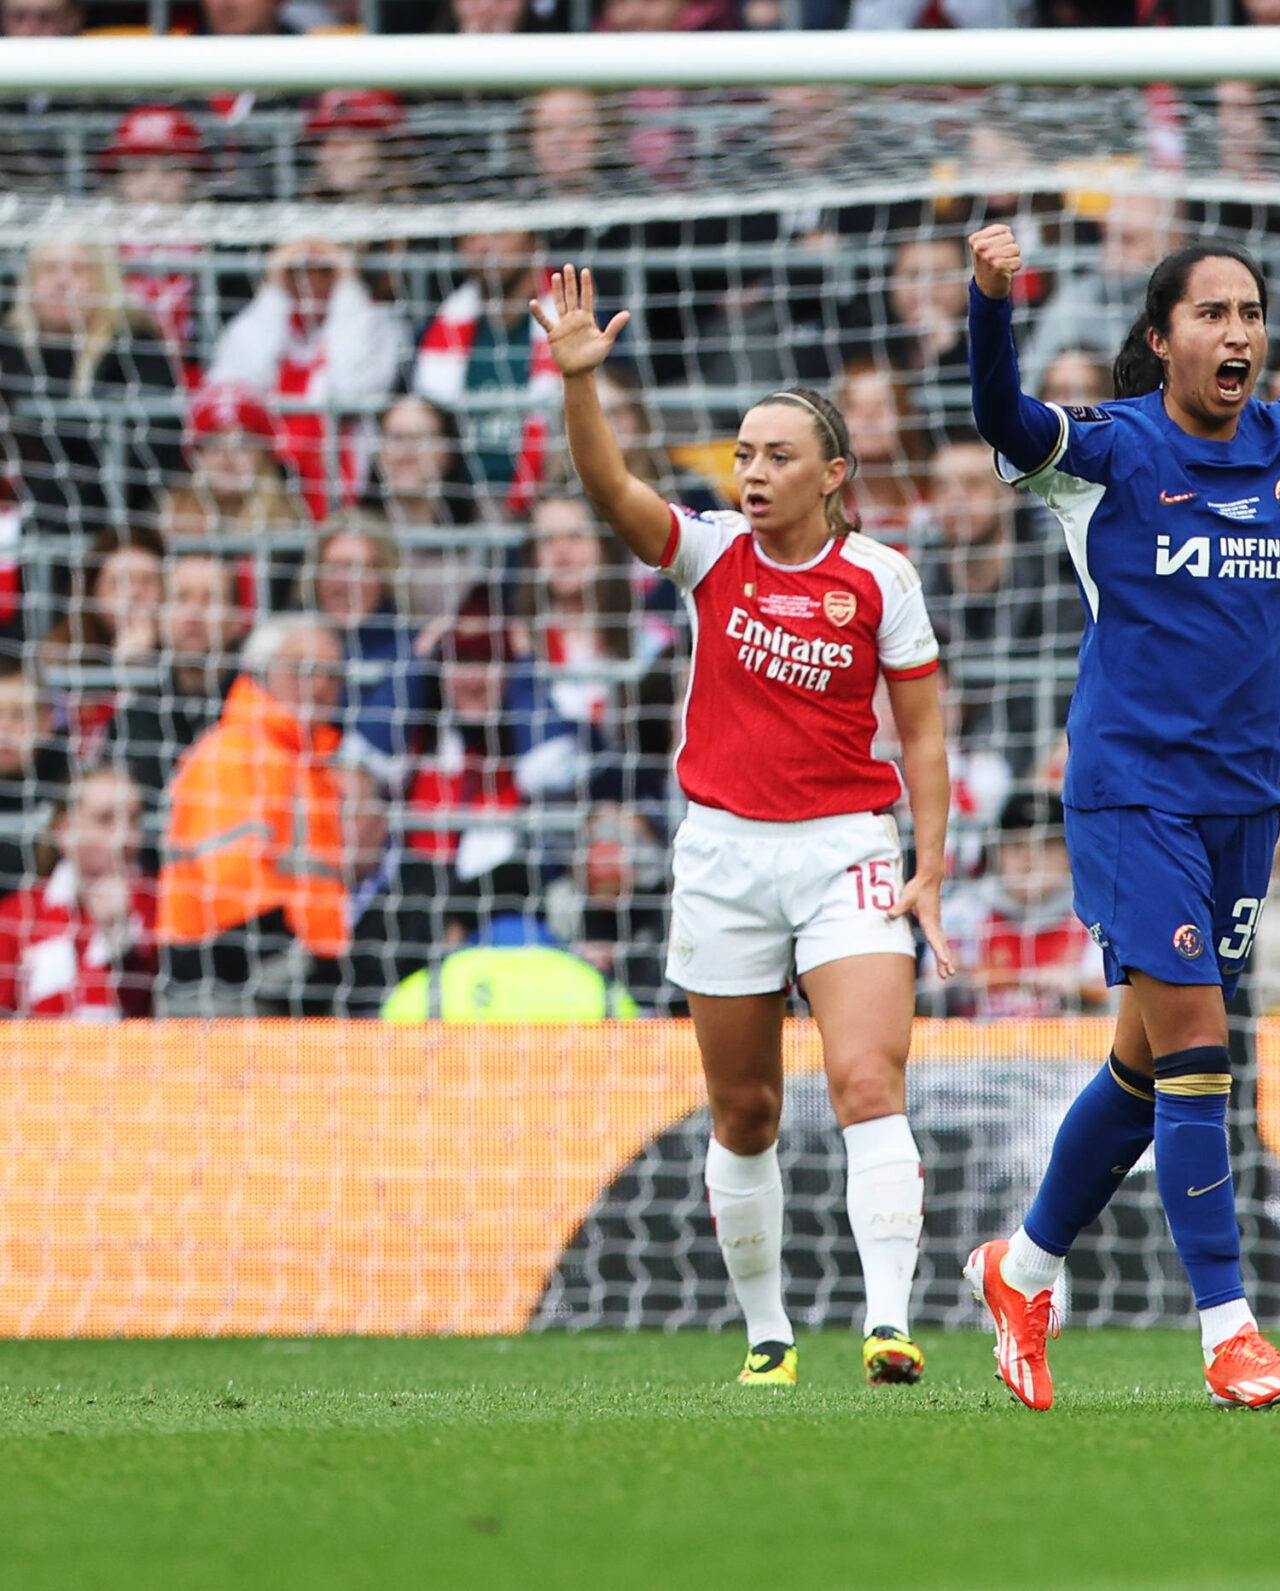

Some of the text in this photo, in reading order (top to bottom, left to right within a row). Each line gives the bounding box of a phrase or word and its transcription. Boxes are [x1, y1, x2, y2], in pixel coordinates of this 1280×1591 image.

[725, 606, 854, 668] Emirates
[737, 644, 832, 692] FLY BETTER
[846, 861, 896, 911] 15
[1218, 897, 1266, 959] 3
